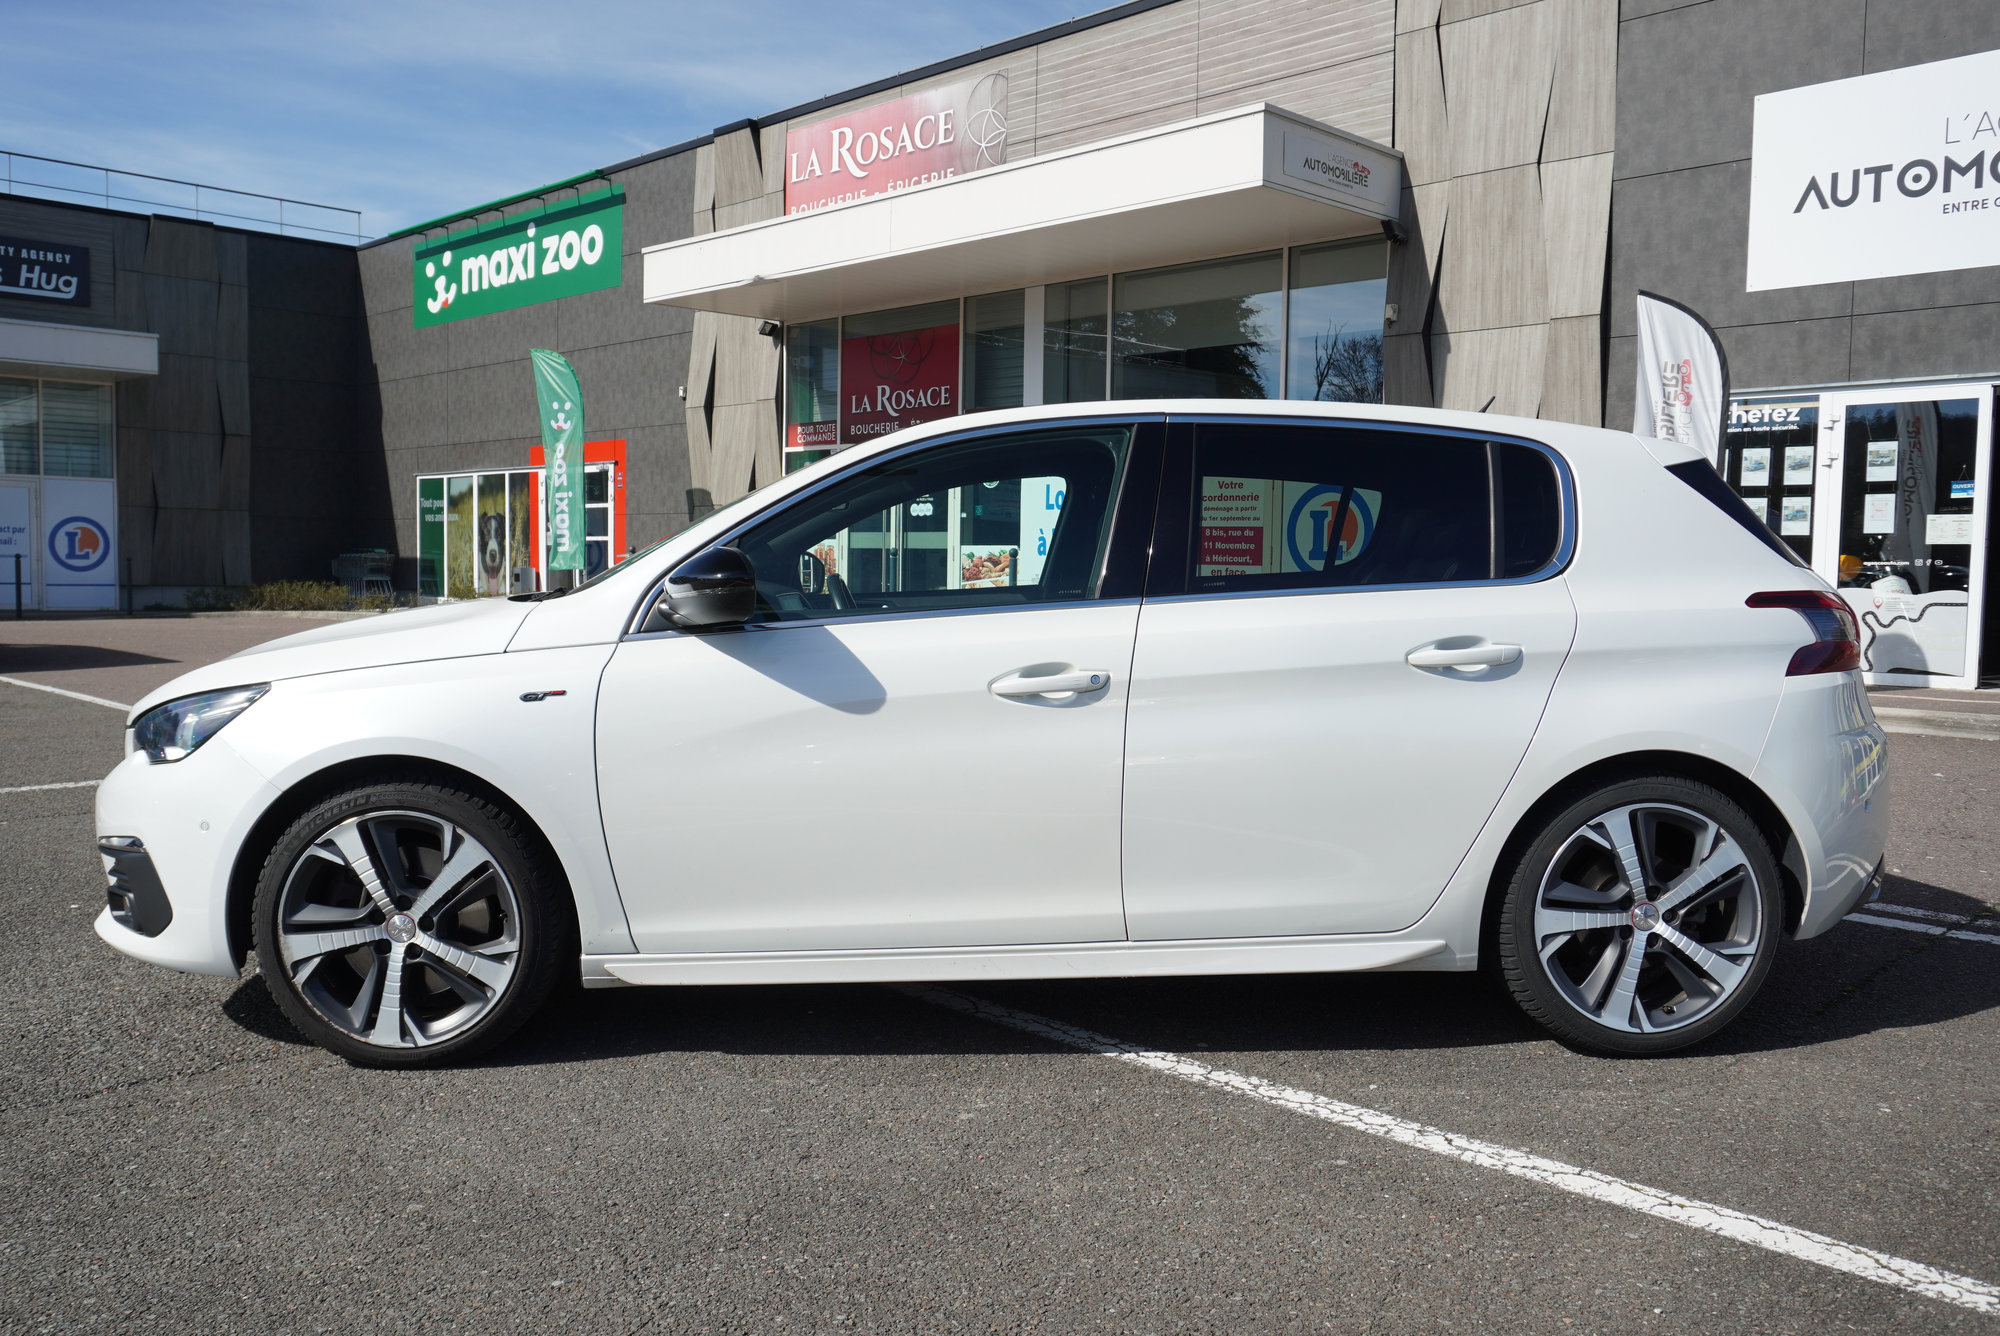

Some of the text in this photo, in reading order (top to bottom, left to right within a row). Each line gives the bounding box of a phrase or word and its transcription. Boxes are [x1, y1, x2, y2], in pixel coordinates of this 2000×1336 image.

[1945, 110, 2000, 145] L'A
[791, 108, 955, 183] LA ROSACE
[1793, 150, 2000, 214] AUTOM
[1942, 198, 1990, 215] ENTRE
[21, 248, 71, 264] AGENCY
[461, 221, 604, 295] maxi zoo
[19, 264, 78, 299] Hug
[851, 384, 950, 417] LA ROSACE
[797, 423, 836, 435] POUR TOUTE
[850, 421, 900, 436] BOUCHERIE
[797, 431, 836, 443] COMMANDE
[1218, 480, 1244, 490] Votre
[420, 498, 433, 508] Tout
[1202, 493, 1260, 502] cordonnerie
[425, 514, 434, 522] vos
[12, 527, 26, 535] par
[1205, 528, 1210, 536] 8
[1212, 528, 1226, 538] bis,
[1243, 528, 1254, 536] du
[1204, 541, 1256, 550] 11 Novembre
[1205, 553, 1253, 564] à Héricourt,
[1210, 567, 1247, 576] en face
[298, 796, 368, 838] MICHELIN
